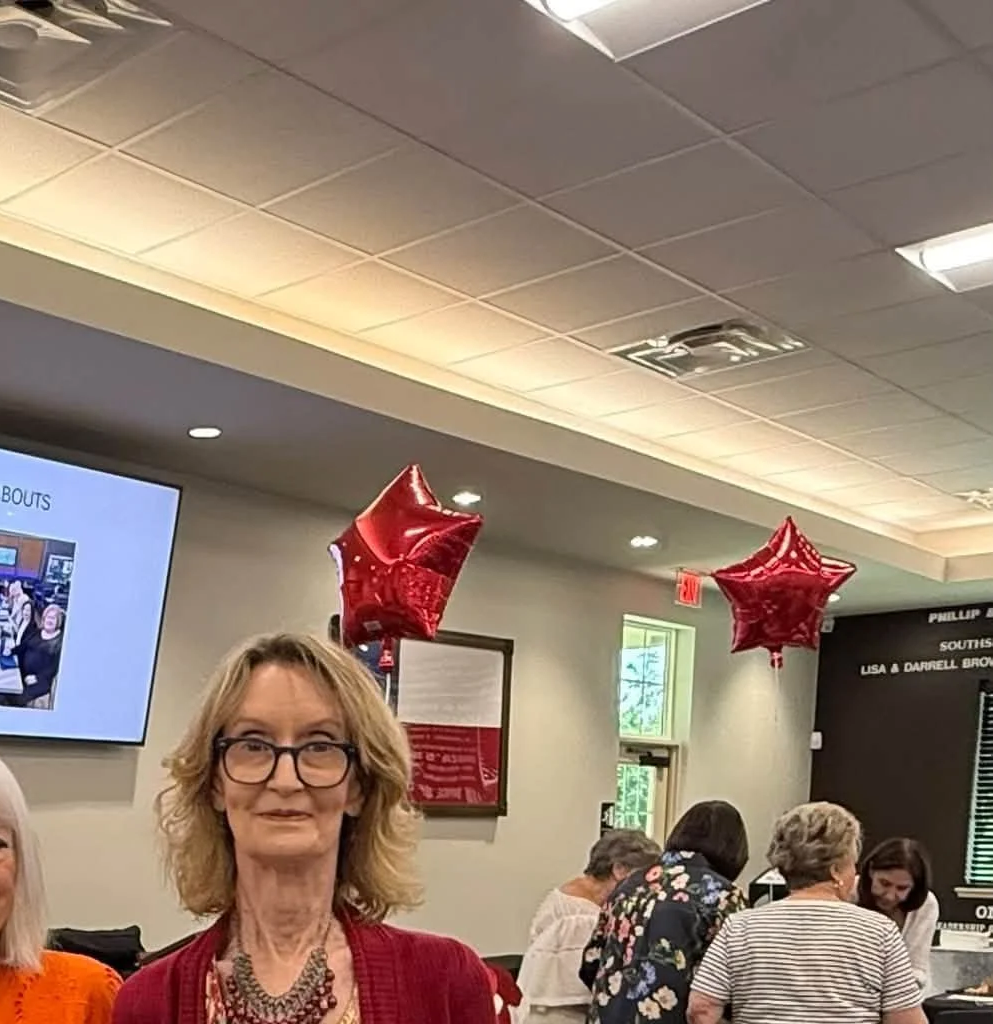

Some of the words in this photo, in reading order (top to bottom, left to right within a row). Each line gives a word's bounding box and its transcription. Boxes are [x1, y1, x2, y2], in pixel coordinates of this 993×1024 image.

[928, 609, 981, 623] PHILLIP
[939, 638, 993, 652] SOUTHS
[861, 664, 887, 675] LISA
[904, 659, 958, 673] DARRELL
[937, 921, 986, 932] EADERSHIP
